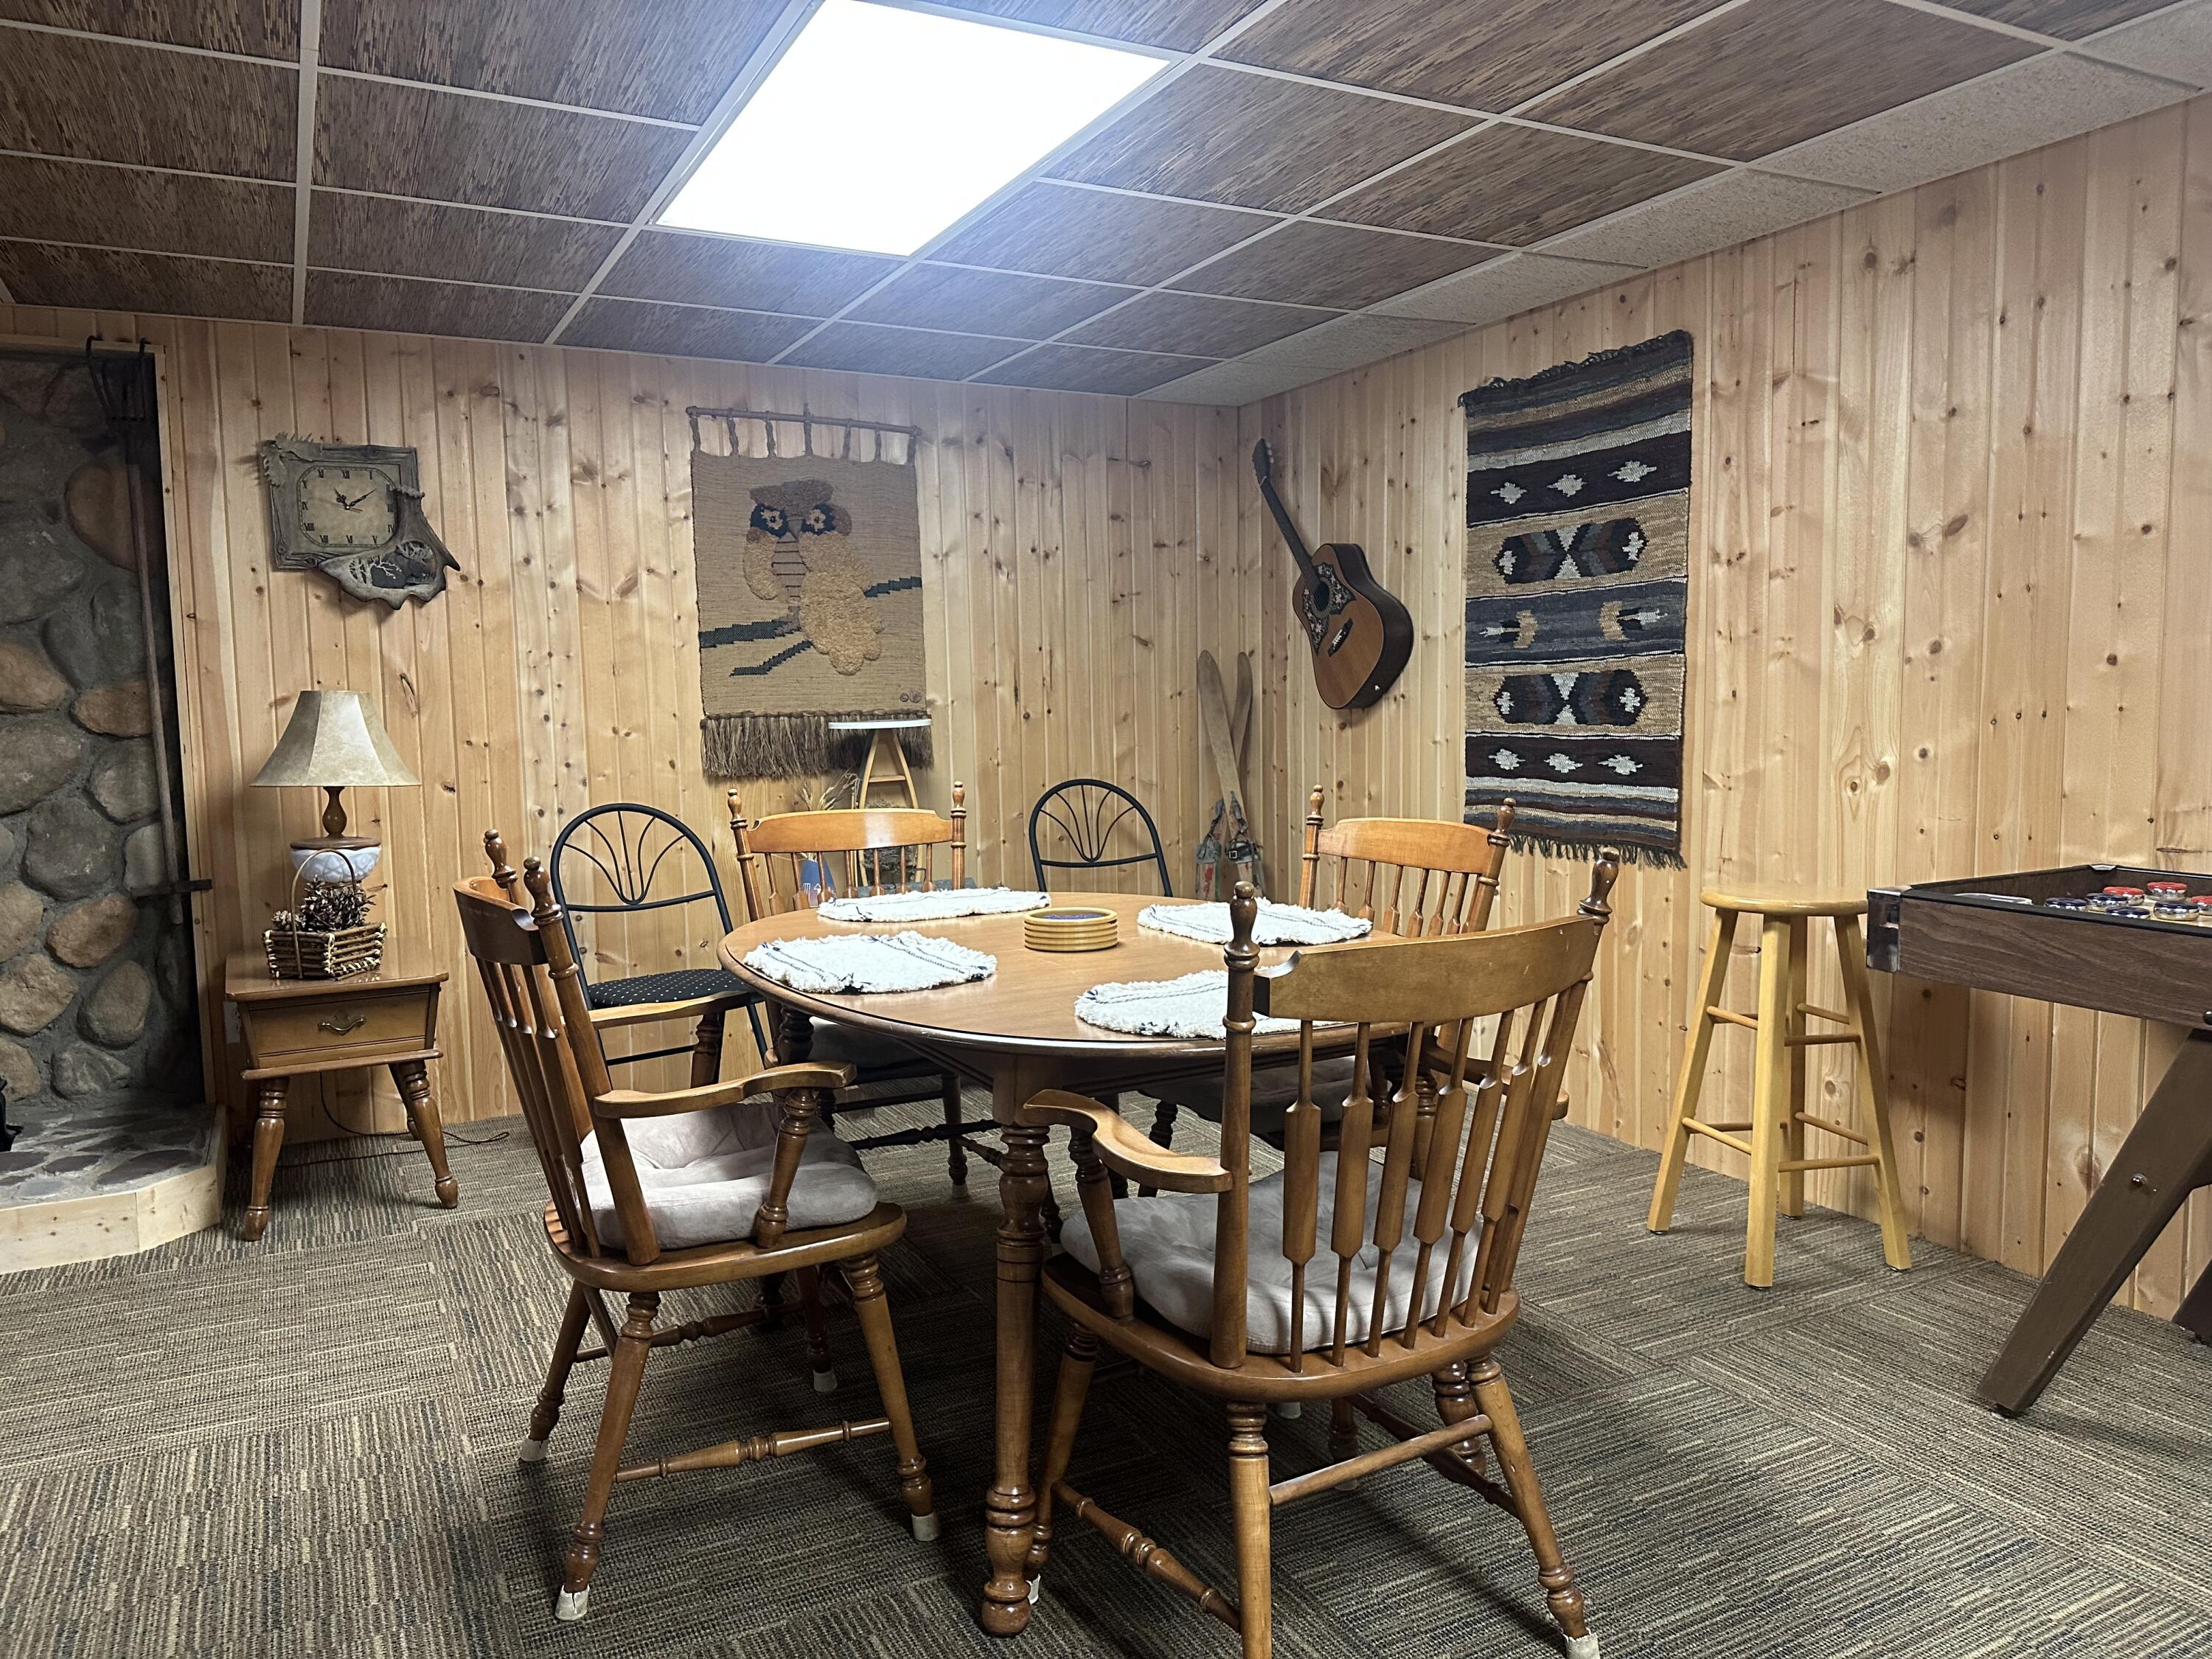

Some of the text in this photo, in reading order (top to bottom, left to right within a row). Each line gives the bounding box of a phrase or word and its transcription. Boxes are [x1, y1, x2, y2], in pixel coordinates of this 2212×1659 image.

[342, 470, 350, 479] XII
[302, 479, 308, 490] X
[319, 535, 329, 543] VII
[346, 535, 353, 544] VI
[372, 535, 378, 544] V
